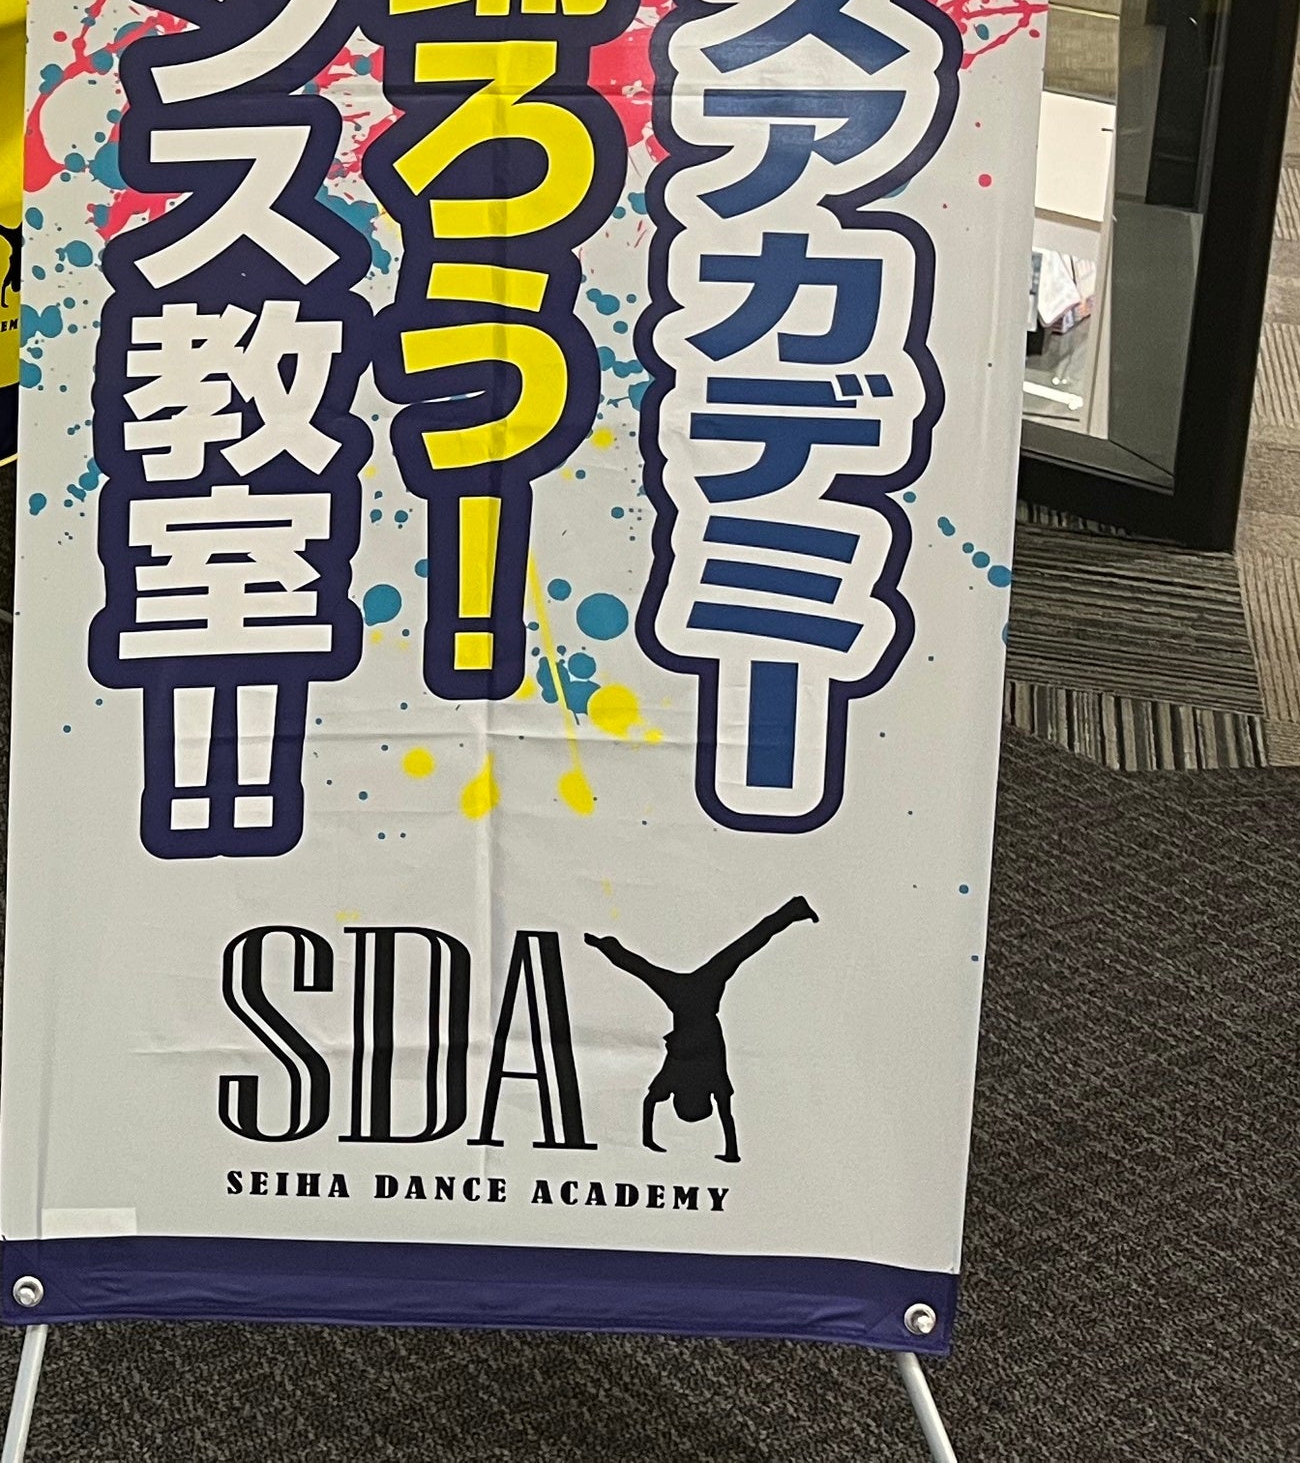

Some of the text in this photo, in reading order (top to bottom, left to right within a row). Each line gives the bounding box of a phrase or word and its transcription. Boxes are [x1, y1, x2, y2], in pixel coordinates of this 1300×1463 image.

[217, 925, 598, 1151] SDA
[226, 1168, 732, 1213] SEIHA DANCE ACADEMY
